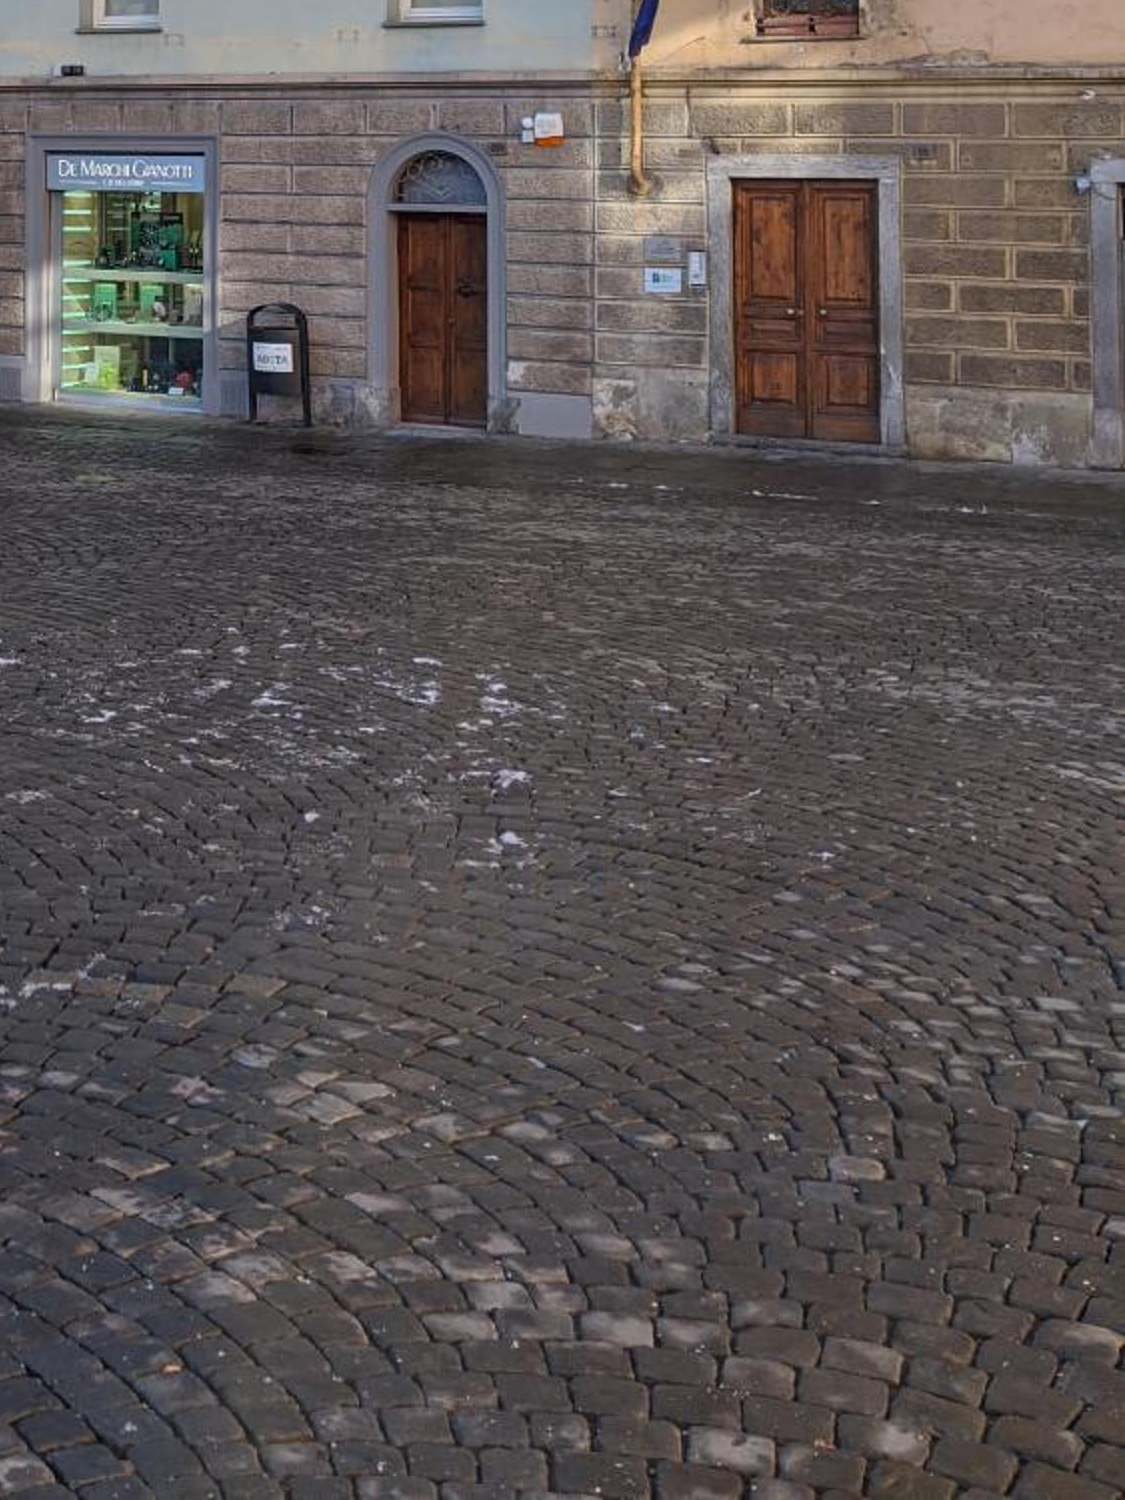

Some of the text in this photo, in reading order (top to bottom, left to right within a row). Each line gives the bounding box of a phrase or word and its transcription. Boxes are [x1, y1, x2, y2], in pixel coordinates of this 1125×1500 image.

[58, 159, 192, 178] DE MARCHI GIANOTTI
